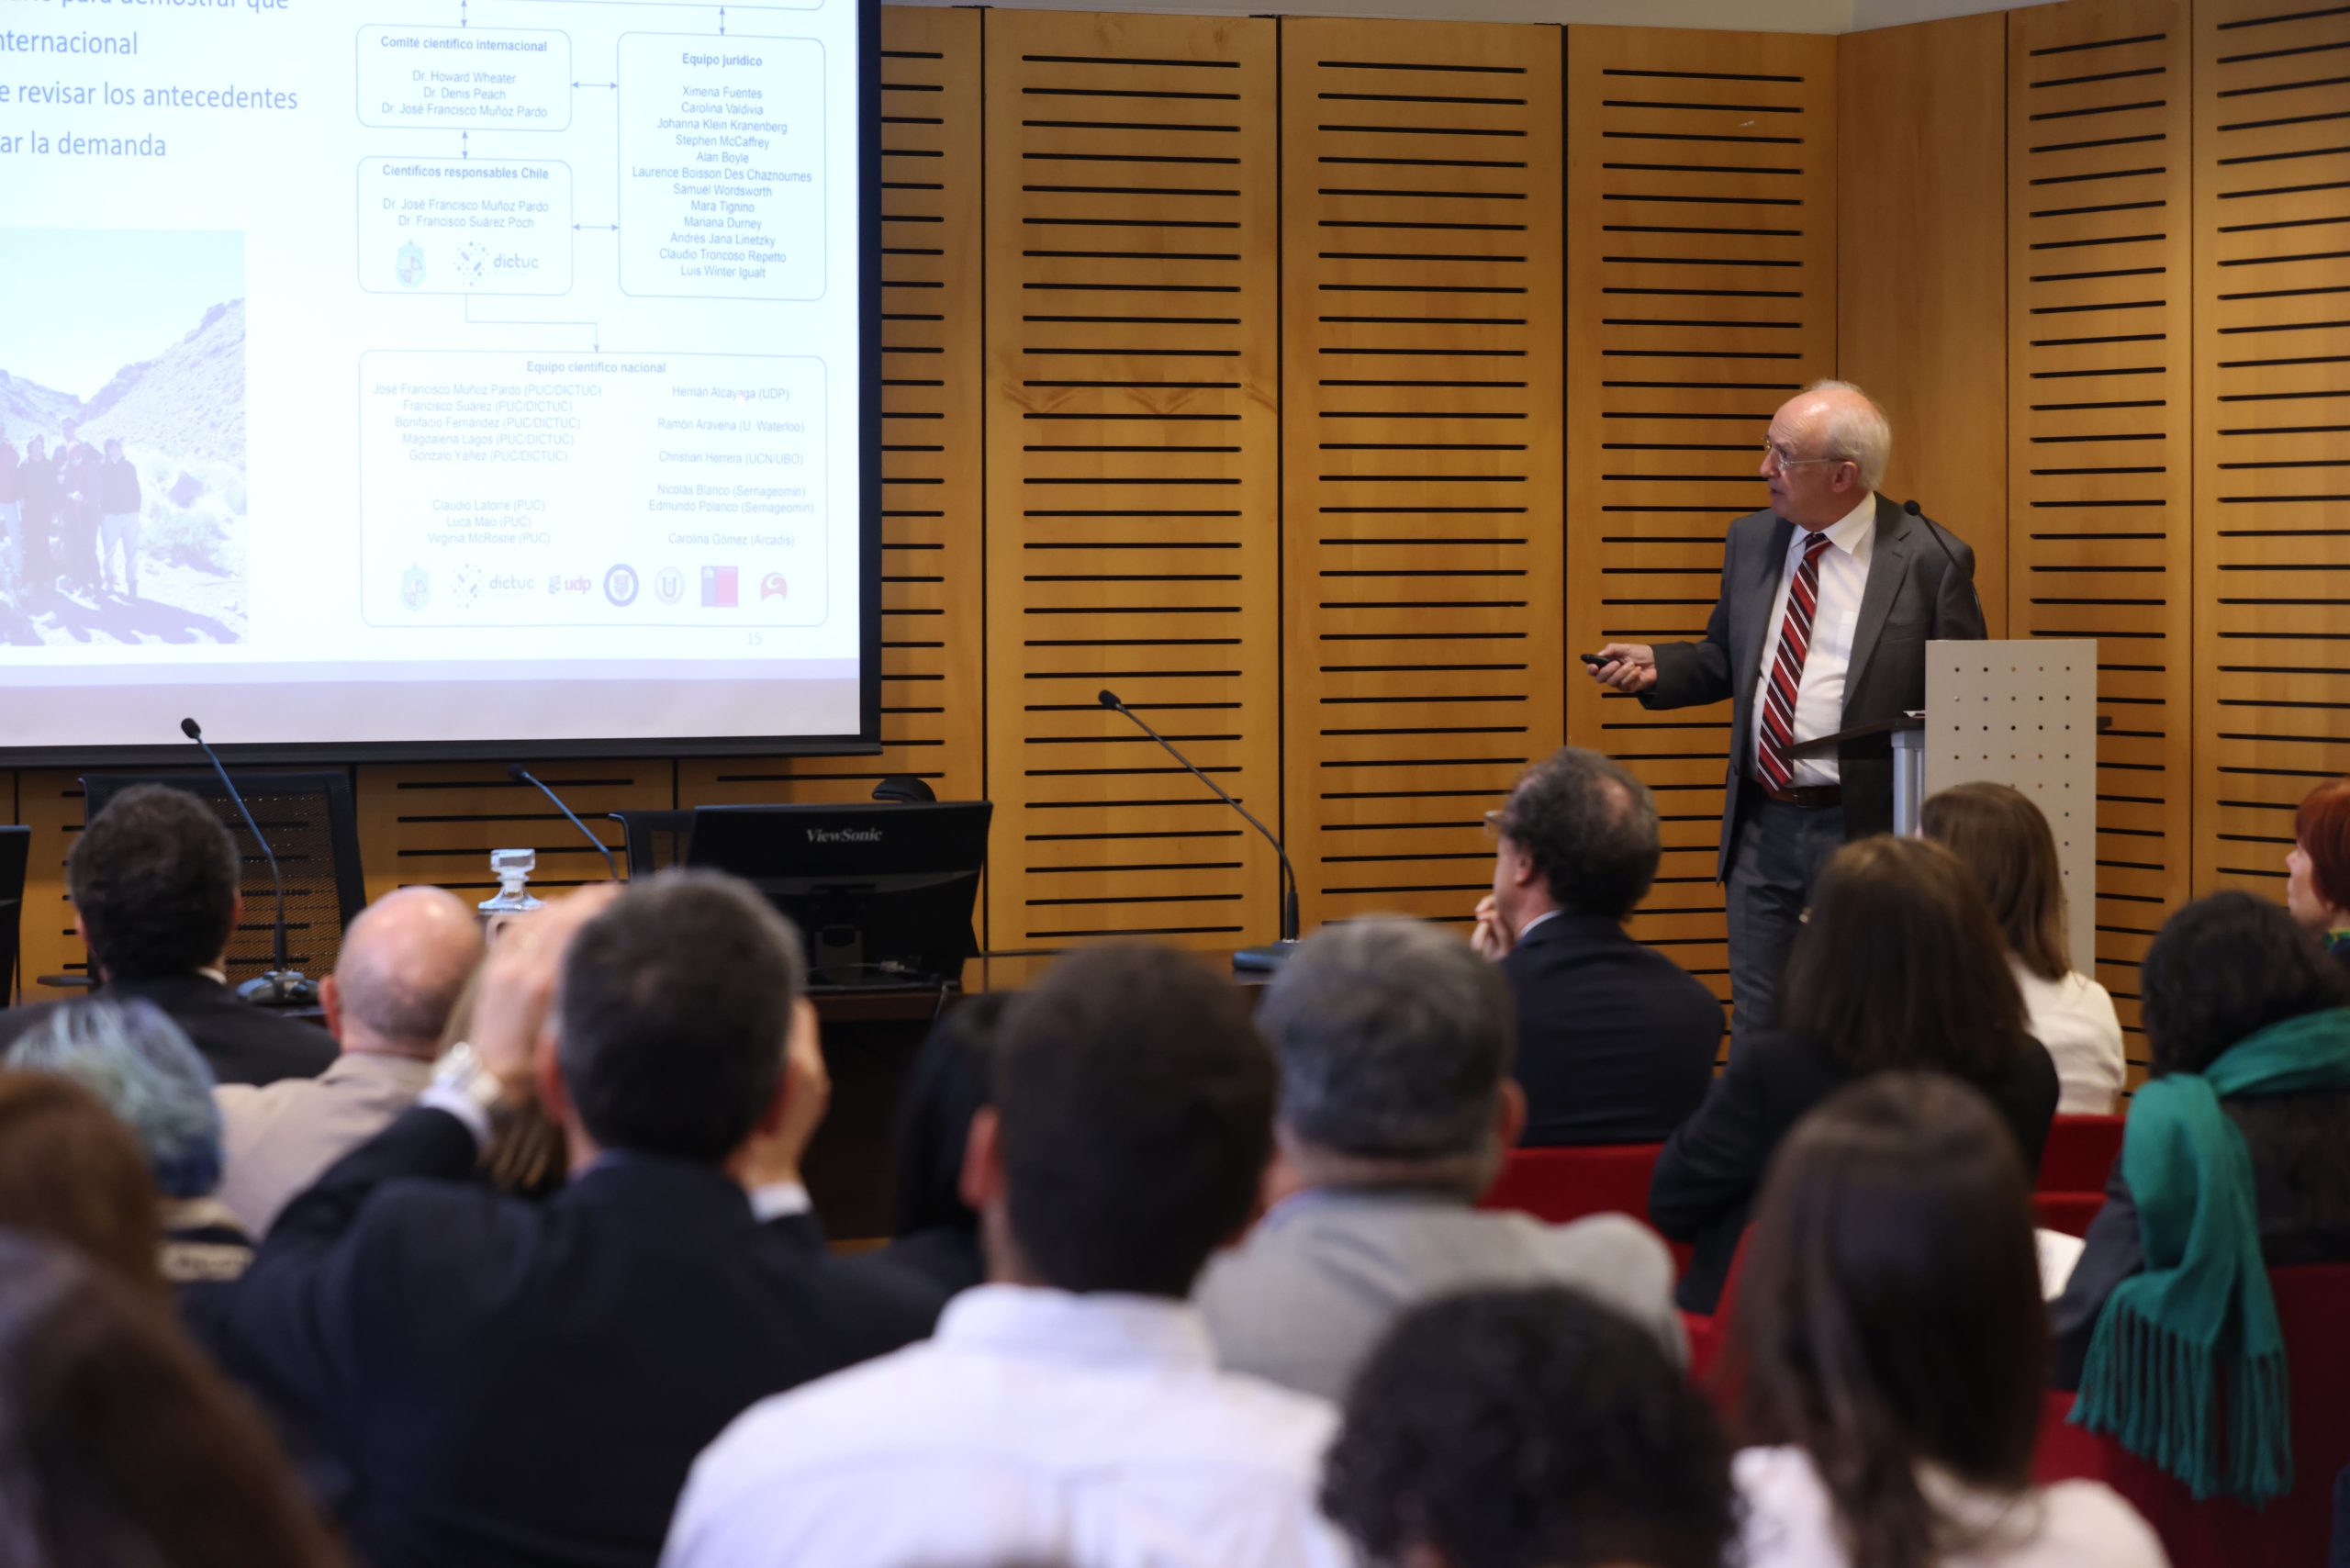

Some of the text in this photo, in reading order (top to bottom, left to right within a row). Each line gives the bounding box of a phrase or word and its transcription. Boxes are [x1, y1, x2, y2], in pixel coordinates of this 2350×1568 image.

[381, 36, 420, 48] Comité
[476, 39, 547, 51] internacional
[683, 53, 720, 67] Equipo
[431, 71, 469, 83] Howard
[474, 72, 516, 84] Wheater
[18, 81, 95, 105] revisar
[105, 82, 135, 106] los
[143, 84, 297, 110] antecedentes
[442, 87, 470, 99] Denis
[474, 88, 506, 99] Peach
[683, 85, 763, 99] Ximena Fuentes
[399, 103, 423, 114] José
[427, 104, 476, 116] Francisco
[480, 105, 514, 117] Muñoz
[518, 106, 547, 118] Pardo
[681, 102, 763, 116] Carolina Valdivia
[657, 118, 788, 135] Johanna Klein Kranenberg
[32, 131, 50, 154] la
[59, 131, 166, 157] demanda
[676, 134, 769, 150] Stephen McCaffrey
[697, 151, 749, 165] Alan Boyle
[444, 166, 518, 179] responsables
[521, 167, 549, 179] Chile
[632, 166, 678, 178] Laurence
[682, 167, 721, 179] Boisson
[725, 169, 744, 180] Des
[674, 184, 772, 196] Samuel Wordsworth
[400, 199, 425, 210] José
[429, 199, 477, 210] Francisco
[481, 200, 515, 211] Muñoz
[519, 201, 549, 212] Pardo
[691, 200, 755, 214] Mara Tignino
[417, 216, 465, 227] Francisco
[509, 217, 534, 228] Poch
[684, 217, 762, 230] Mariana Durney
[709, 233, 733, 244] Jana
[494, 253, 539, 268] dictuc
[660, 249, 786, 263] Claudio Troncoso Repetto
[681, 265, 700, 275] Luis
[704, 266, 734, 276] Winter
[527, 361, 565, 375] Equipo
[621, 363, 666, 373] nacional
[373, 383, 397, 394] José
[401, 384, 450, 395] Francisco
[453, 384, 487, 395] Muñoz
[491, 385, 520, 395] Pardo
[758, 388, 789, 401] (UDP)
[403, 400, 453, 411] Francisco
[396, 417, 442, 428] Bonifacio
[696, 419, 736, 431] Aravena
[757, 420, 804, 433] Waterloo)
[403, 433, 458, 446] Magdalena
[659, 451, 702, 463] Christian
[706, 453, 742, 464] Herrera
[697, 484, 730, 496] Blanco
[733, 485, 805, 499] (Sernageomin)
[432, 499, 545, 512] Claudio Latorre (PUC)
[649, 499, 814, 515] Edmundo Polanco (Sernageomin)
[447, 517, 471, 527] Luca
[499, 517, 532, 529] (PUC)
[428, 532, 551, 546] Virginia McRostie (PUC)
[668, 532, 709, 544] Carolina
[751, 534, 795, 547] (Arcadis)
[489, 575, 534, 589] dictuc
[565, 575, 591, 594] udp
[807, 828, 882, 842] ViewSonic
